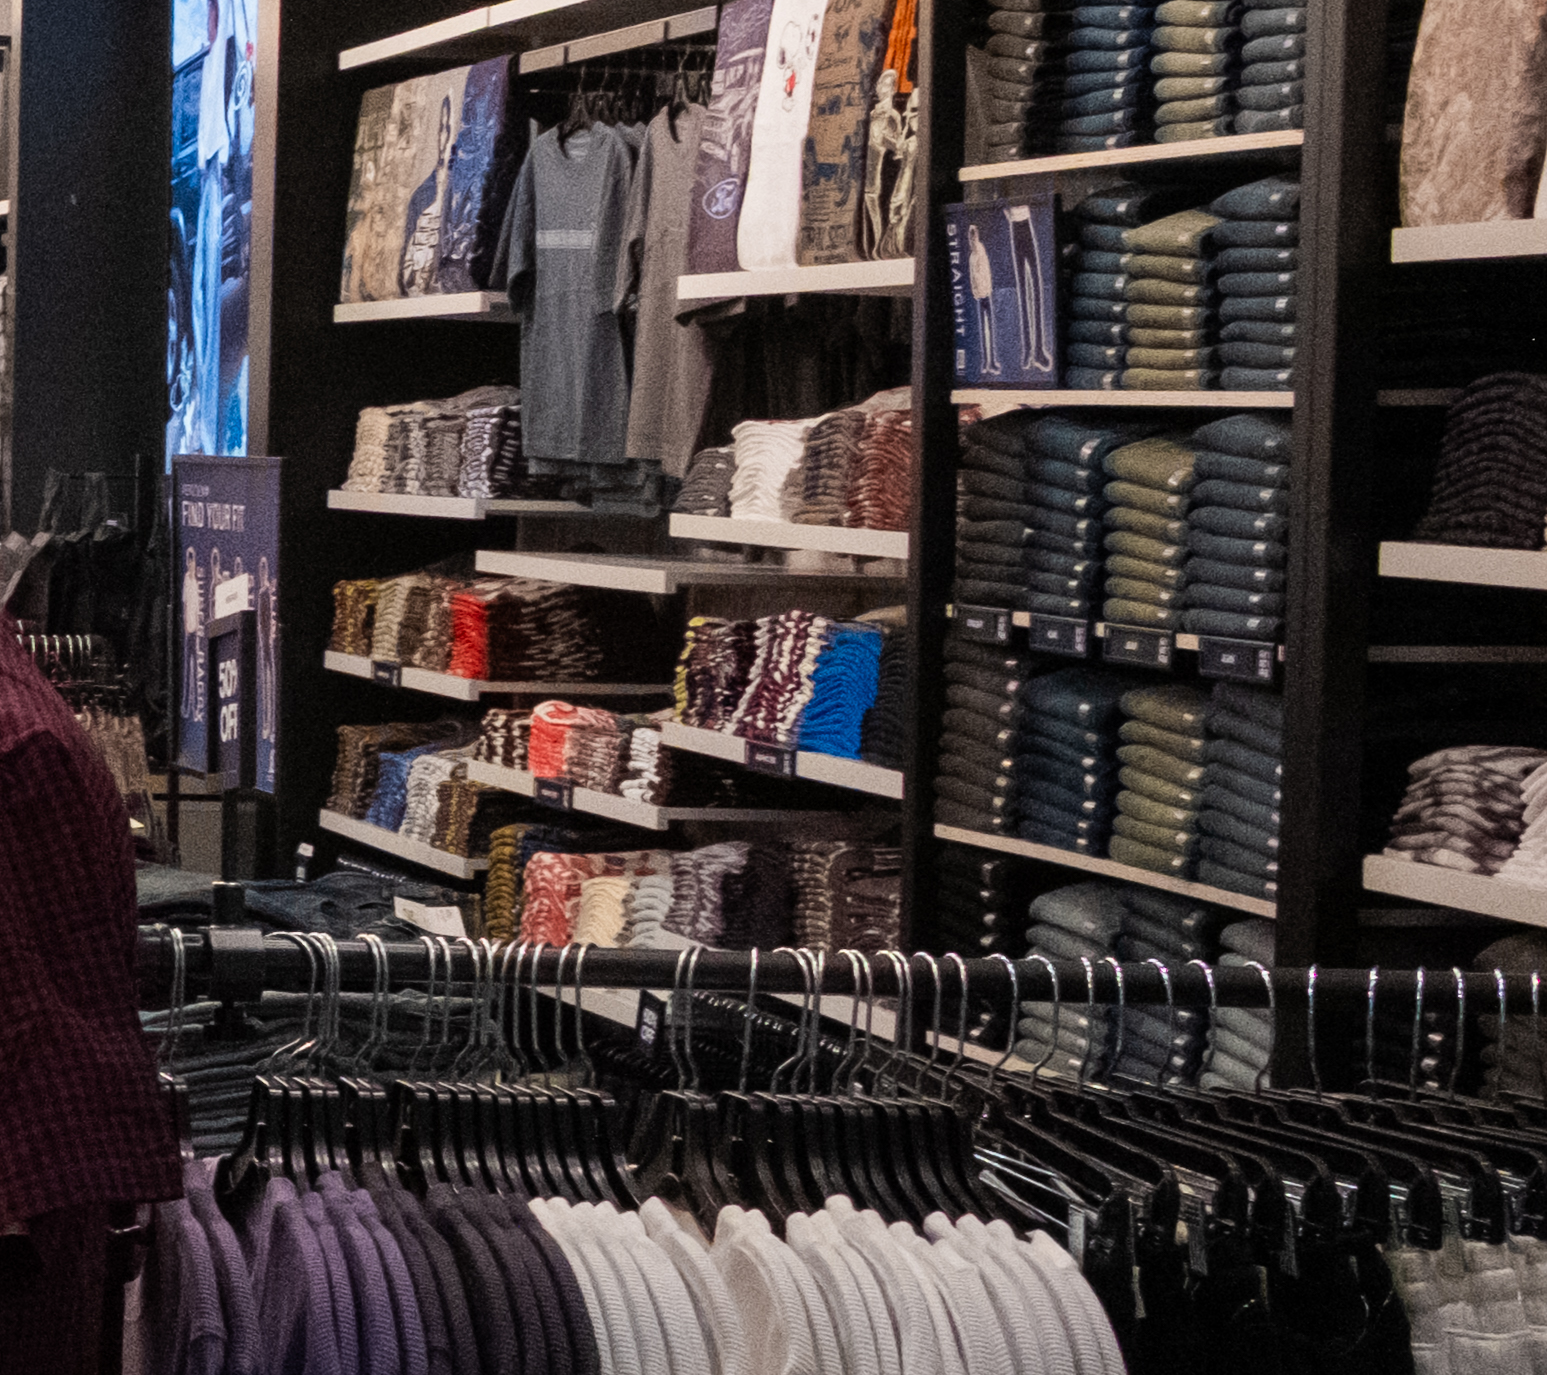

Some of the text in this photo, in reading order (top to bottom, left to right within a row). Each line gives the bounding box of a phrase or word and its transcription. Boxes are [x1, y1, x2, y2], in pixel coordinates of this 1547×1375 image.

[946, 224, 966, 336] STRAIGHT
[182, 500, 204, 528] FIND
[219, 702, 238, 743] OFF
